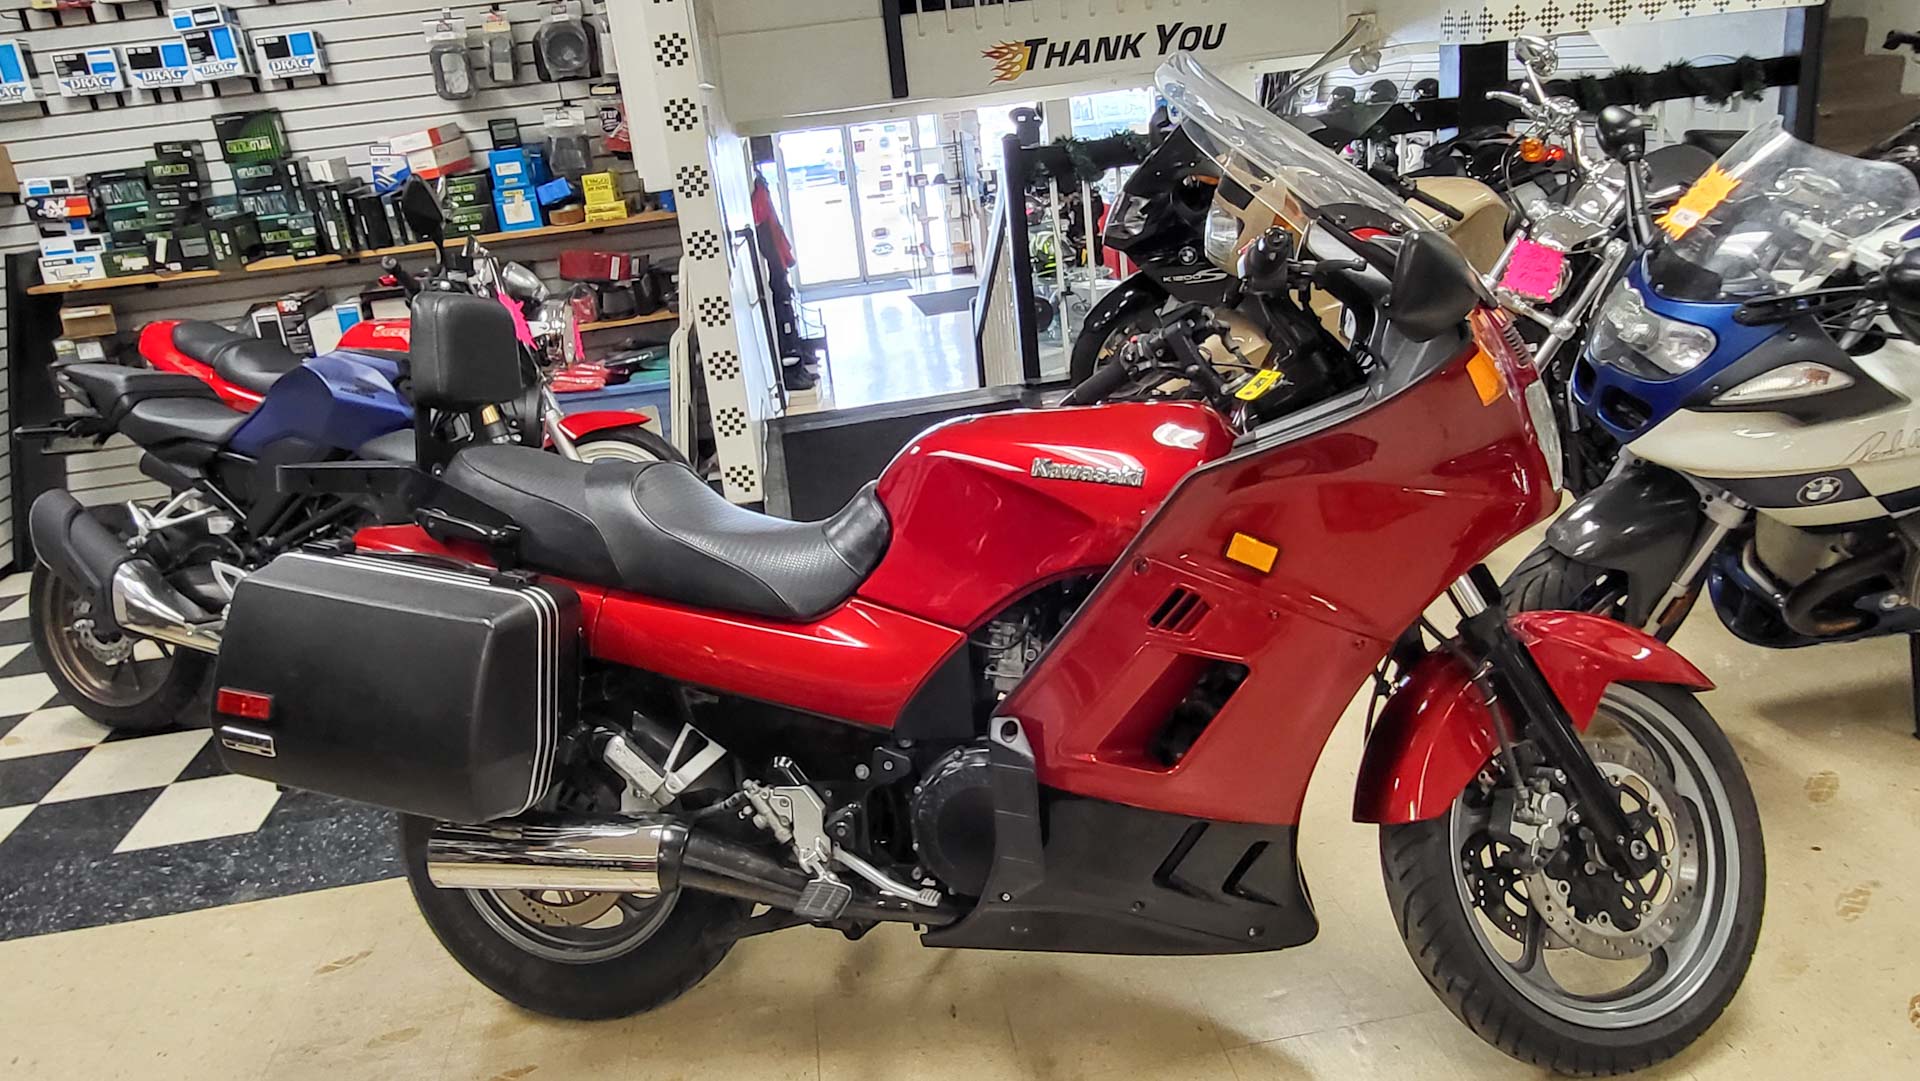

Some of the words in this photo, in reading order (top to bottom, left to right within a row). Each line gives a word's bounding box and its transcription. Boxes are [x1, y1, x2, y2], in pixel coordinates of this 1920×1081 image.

[200, 62, 234, 75] DRAG
[270, 58, 310, 72] DRAG
[141, 68, 183, 82] DRAG
[69, 75, 111, 90] DRAG
[1031, 457, 1147, 487] Kawasaki
